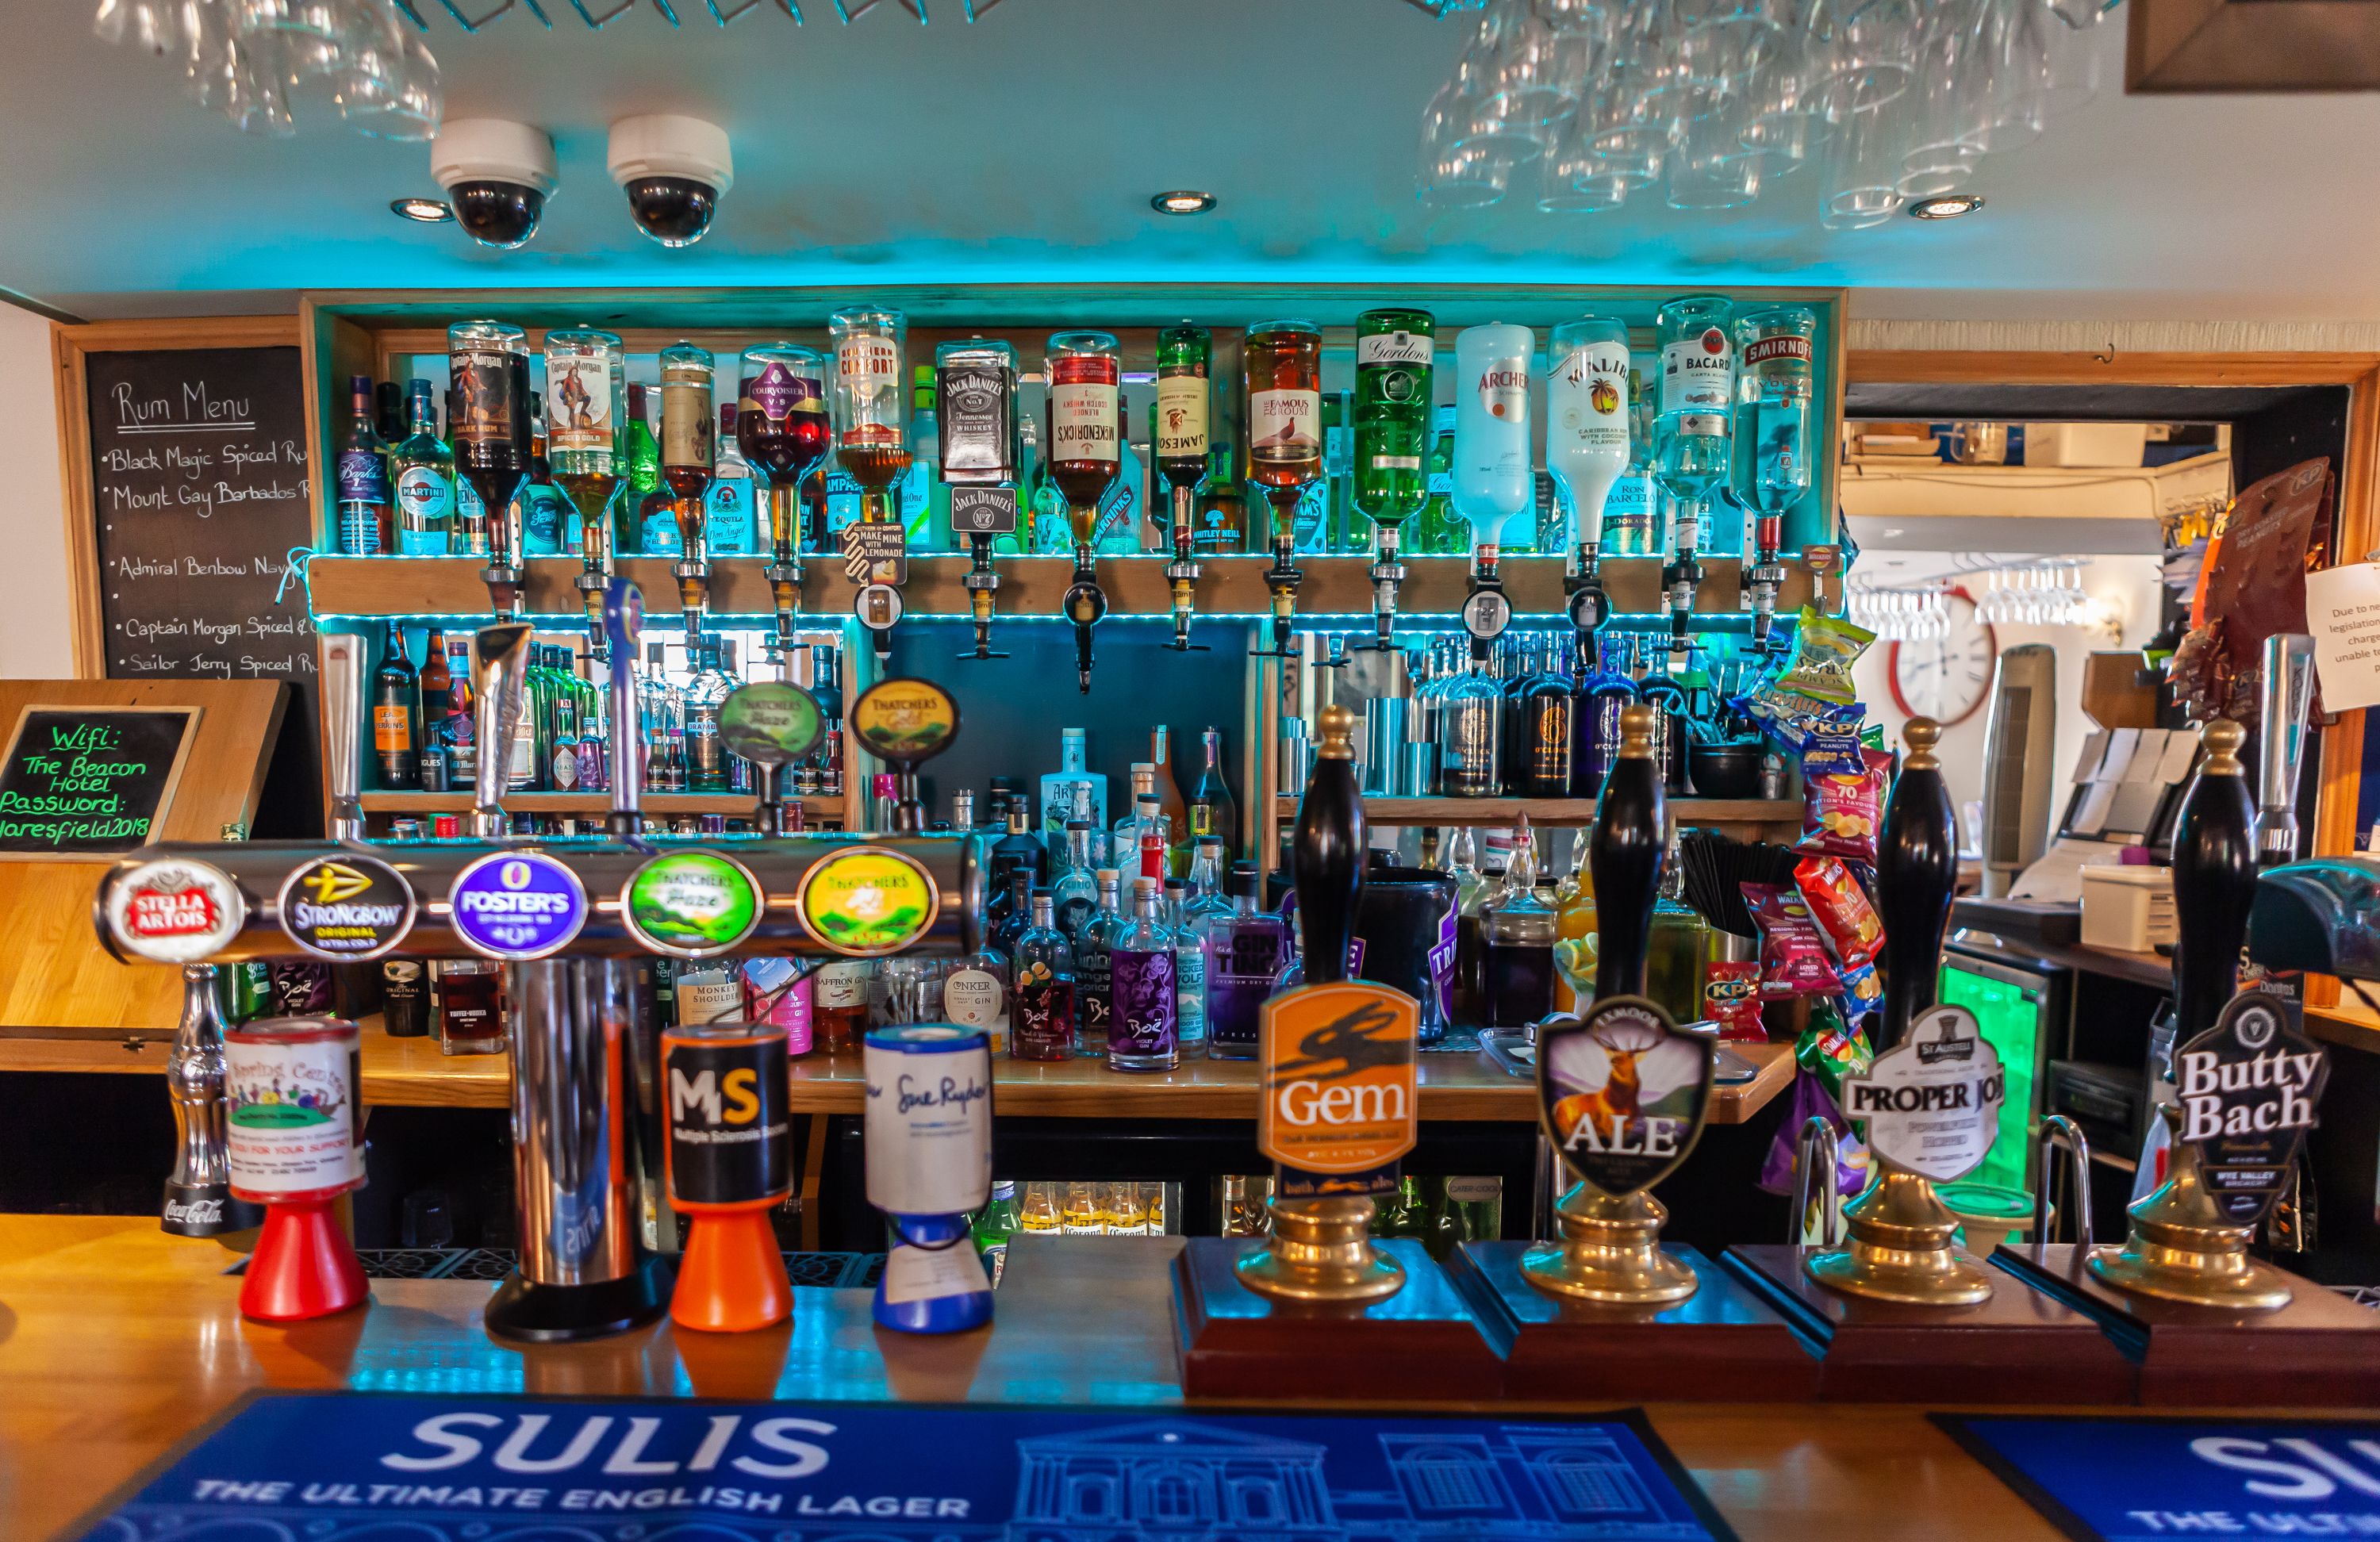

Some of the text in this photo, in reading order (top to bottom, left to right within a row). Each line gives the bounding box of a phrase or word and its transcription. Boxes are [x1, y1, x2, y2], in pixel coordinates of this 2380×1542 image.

[471, 353, 502, 368] Morgan
[842, 346, 892, 358] SOUTHERN
[551, 360, 601, 374] Captain Morgan
[842, 359, 893, 375] COMFORT
[946, 374, 1004, 397] JACK DANIEL'S
[1478, 371, 1530, 393] ARCHER
[752, 387, 805, 397] COURVOISIER
[112, 381, 249, 431] Rum Menu
[1270, 399, 1309, 409] FAMOUS
[1270, 408, 1309, 416] GROUSE
[956, 412, 993, 421] Tennessee
[108, 440, 308, 479] Black Magic Spiced Ru
[340, 461, 379, 481] Banks
[403, 487, 444, 497] MARTINI
[827, 478, 859, 492] AMPA
[113, 486, 173, 510] Mount
[178, 485, 213, 518] Gay
[215, 481, 297, 504] Barbados
[909, 493, 923, 502] One
[955, 490, 1013, 513] JACK DANIEL'S
[709, 525, 747, 540] Don Angel
[861, 531, 903, 543] MAKE MINE
[1222, 529, 1241, 538] NEILL
[120, 556, 178, 581] Admiral
[184, 556, 247, 575] Benbow
[2332, 608, 2354, 618] Due
[125, 618, 188, 643] Captain
[193, 619, 241, 644] Morgan
[246, 616, 294, 639] Spiced
[2329, 618, 2380, 634] legislation
[2348, 634, 2380, 646] charge
[2336, 649, 2370, 662] unable
[129, 653, 292, 681] Sailor Jerry Spiced
[1540, 706, 1567, 744] 6
[1818, 721, 1855, 733] KP
[52, 723, 121, 754] Wifi:
[22, 756, 147, 777] The Beacon
[49, 776, 112, 792] Hotel
[1837, 785, 1857, 799] 70
[0, 791, 127, 812] Password:
[1066, 880, 1091, 890] CURIO
[134, 893, 205, 912] STELLA
[461, 890, 570, 914] FOSTER'S
[137, 909, 208, 929] ARTOIS
[295, 903, 404, 928] STRONGBOW
[316, 926, 377, 938] ORIGINAL
[1177, 965, 1203, 974] ICKED
[816, 976, 853, 985] SAFFRON
[697, 984, 735, 995] MONKEY
[1714, 985, 1744, 996] KP
[1127, 1018, 1161, 1038] Boë
[2181, 1048, 2323, 1097] Butty
[671, 1068, 760, 1125] MS
[1279, 1080, 1408, 1126] Gem
[1852, 1082, 1970, 1112] PROPER
[2182, 1084, 2313, 1141] Bach
[710, 1128, 760, 1144] Sclerosis
[1564, 1111, 1678, 1157] ALE
[380, 1411, 838, 1479] SULIS
[192, 1479, 971, 1521] THE ULTIMATE ENGLISH LAGER
[2125, 1509, 2246, 1532] THE
